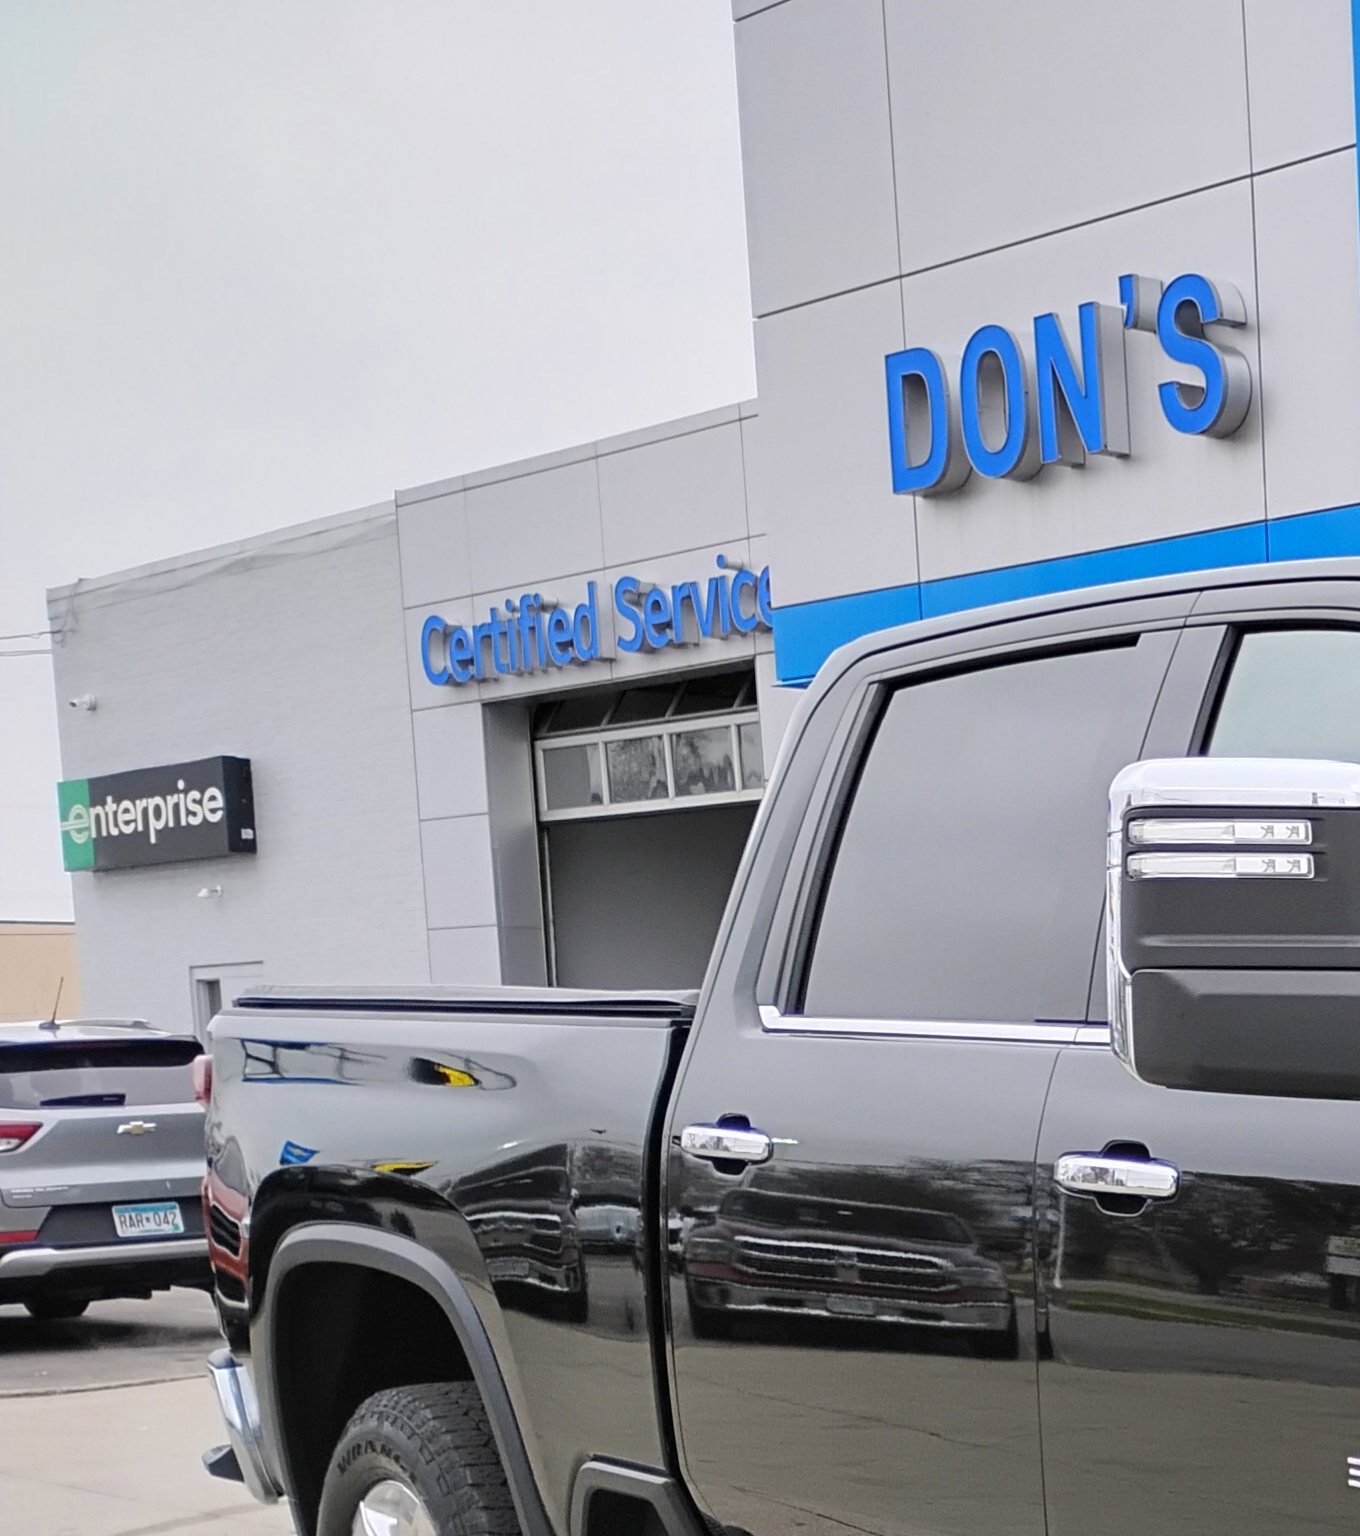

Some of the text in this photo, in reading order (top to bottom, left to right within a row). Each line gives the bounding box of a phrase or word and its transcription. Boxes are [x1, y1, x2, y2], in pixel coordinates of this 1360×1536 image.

[885, 272, 1250, 497] DON'S
[421, 553, 773, 686] Certified Service
[61, 779, 223, 844] enterprise
